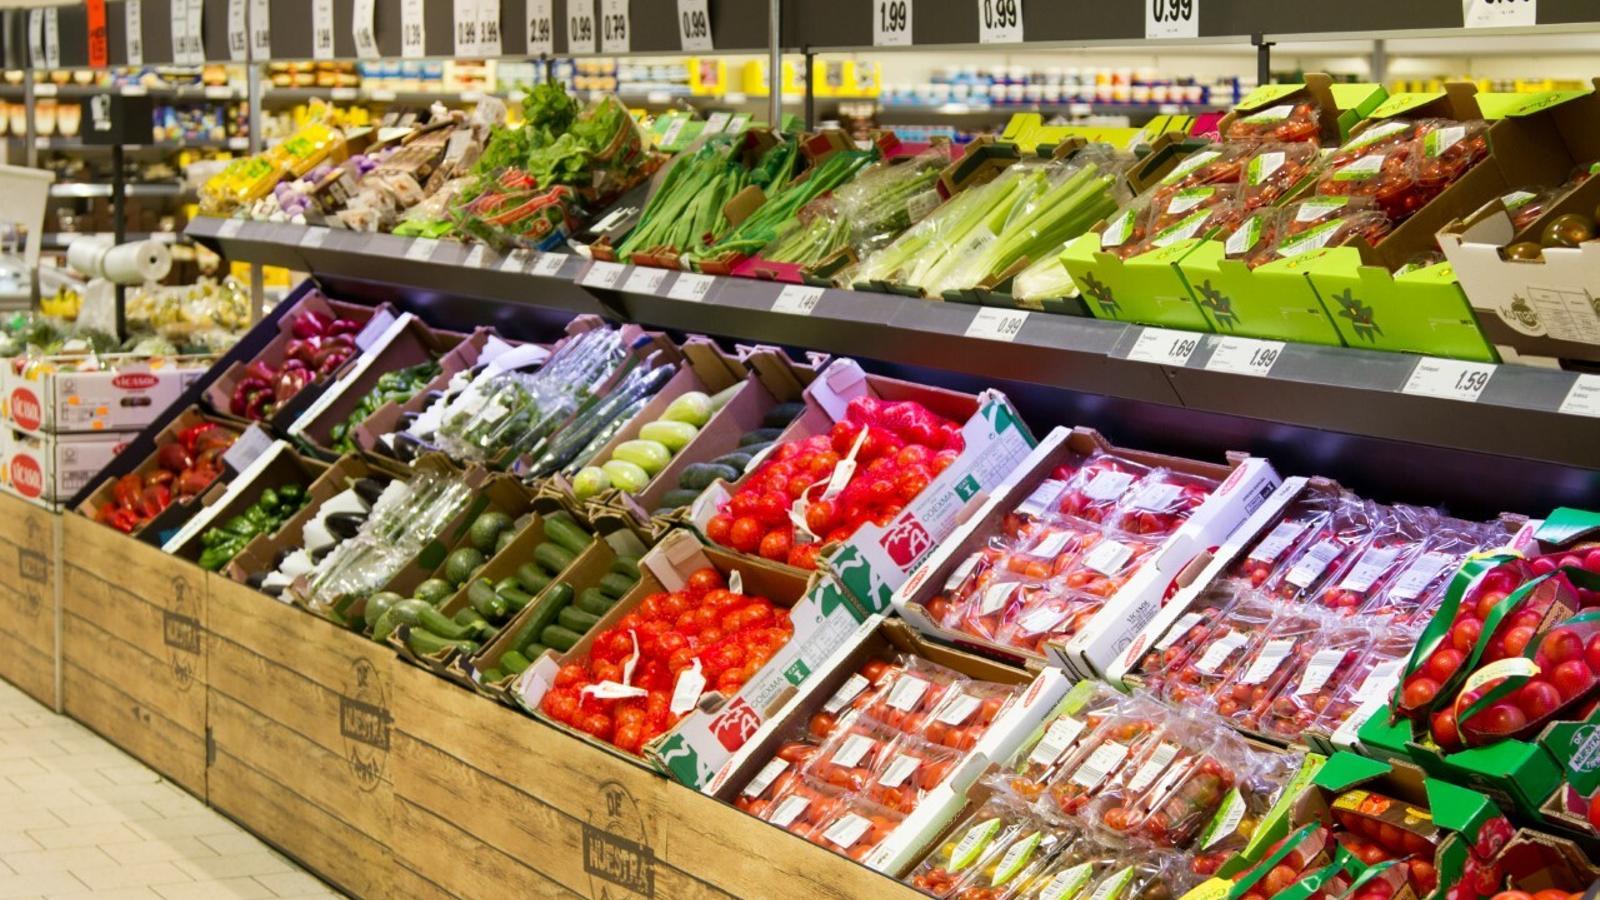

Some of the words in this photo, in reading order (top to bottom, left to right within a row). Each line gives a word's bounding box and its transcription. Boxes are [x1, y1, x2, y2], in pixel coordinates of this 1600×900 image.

[880, 1, 907, 33] 1.99
[984, 0, 1018, 29] 0.99
[1152, 0, 1193, 23] 0.99
[530, 18, 550, 43] 2.99
[571, 16, 592, 42] 0.99
[605, 14, 627, 40] 0.79
[683, 11, 707, 39] 0.99
[997, 316, 1022, 335] 0.99
[1168, 338, 1196, 358] 1.69
[1249, 347, 1278, 367] 1.99
[1455, 370, 1488, 392] 1.59
[588, 835, 649, 895] NUESTRA
